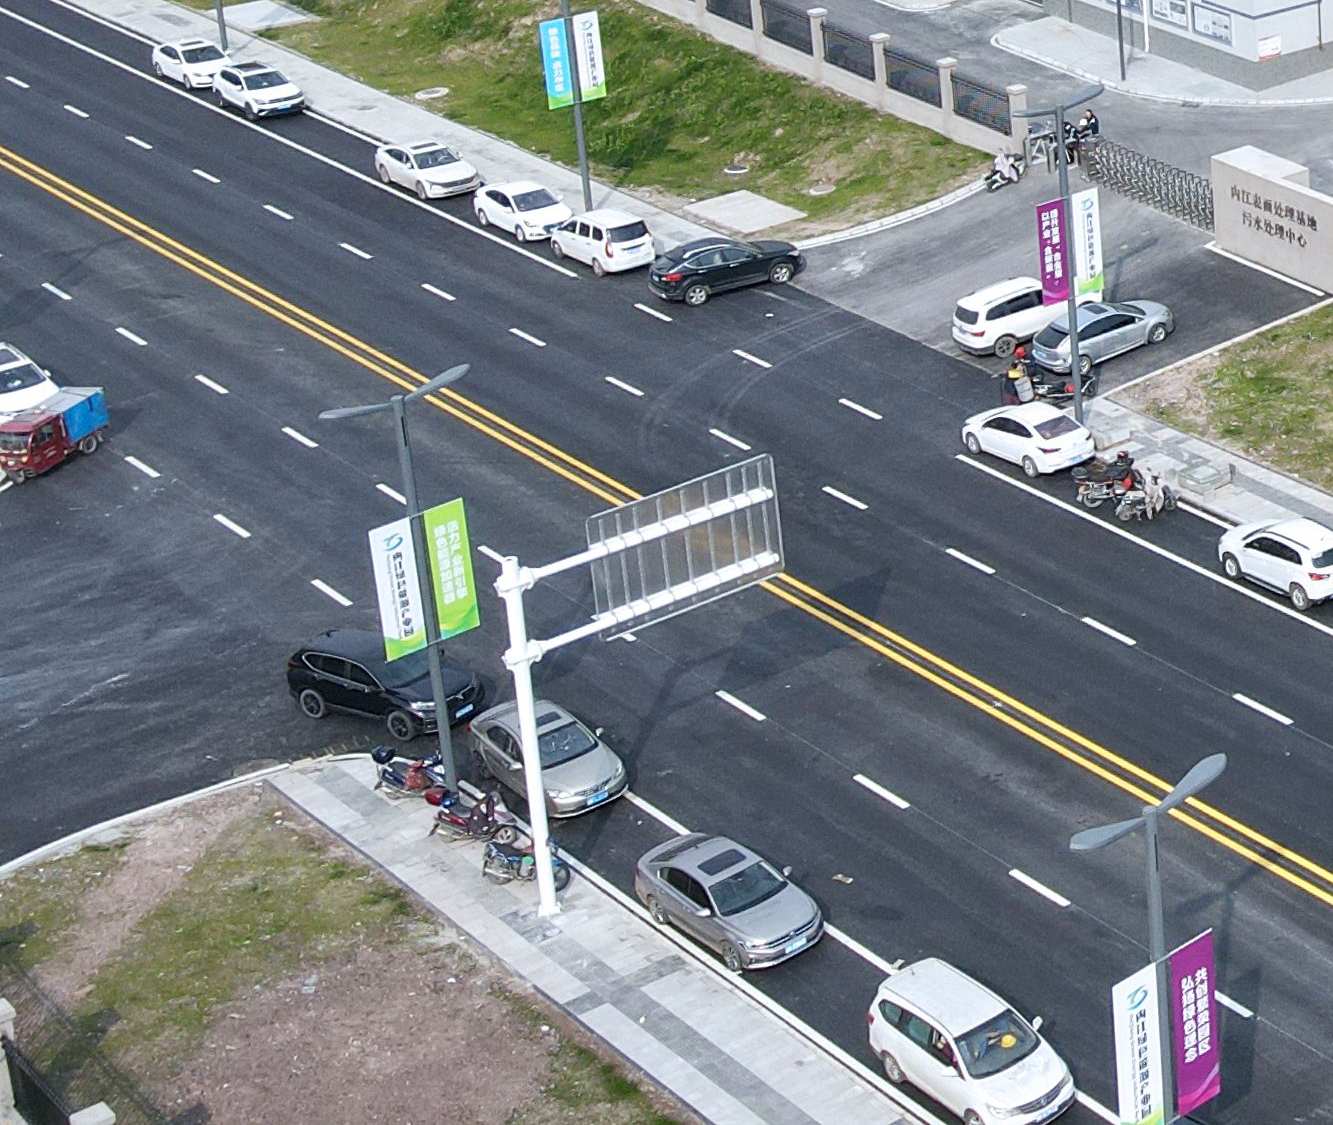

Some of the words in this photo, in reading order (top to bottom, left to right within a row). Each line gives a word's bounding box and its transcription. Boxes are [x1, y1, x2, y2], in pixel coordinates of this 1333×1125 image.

[1231, 184, 1318, 232] 内江表面处理基地
[1242, 210, 1307, 248] 污水处理中心
